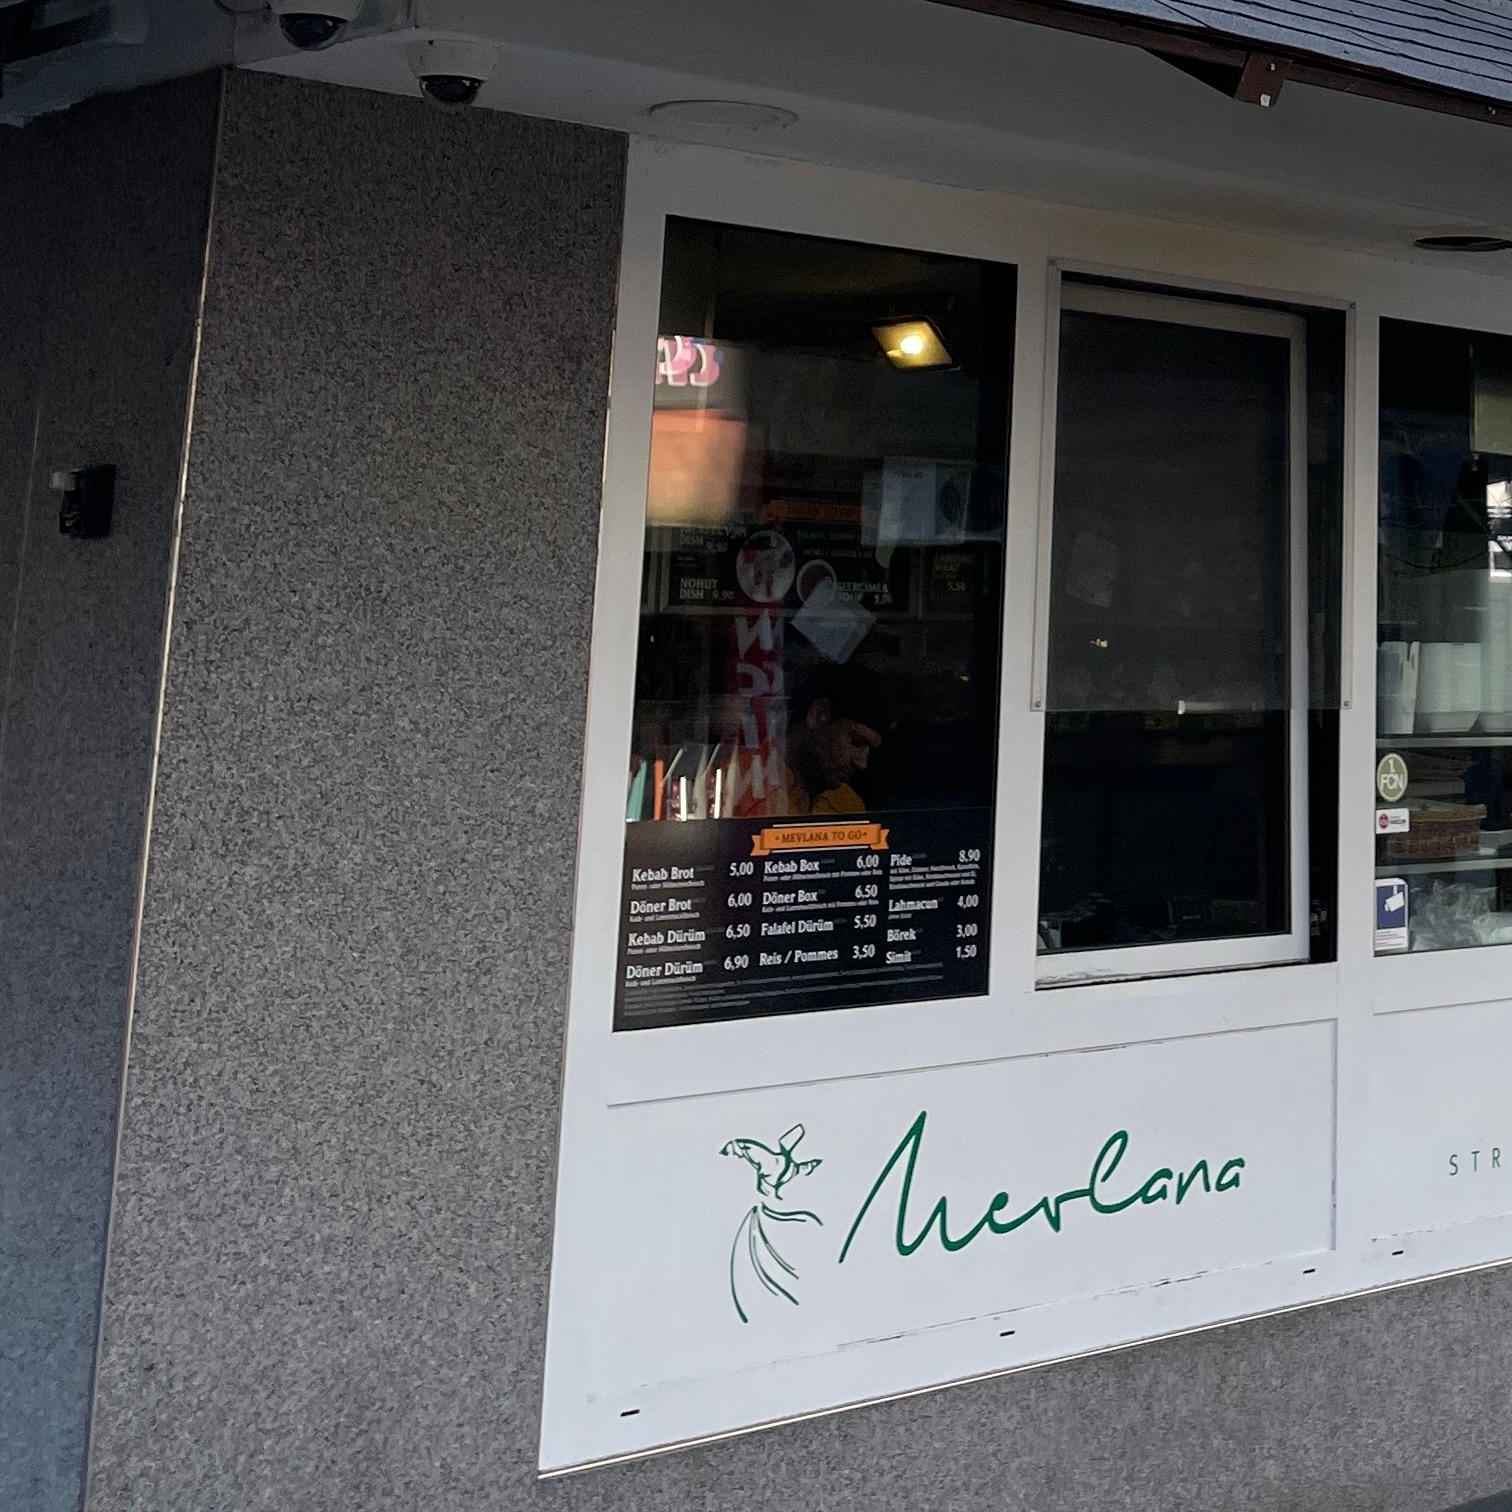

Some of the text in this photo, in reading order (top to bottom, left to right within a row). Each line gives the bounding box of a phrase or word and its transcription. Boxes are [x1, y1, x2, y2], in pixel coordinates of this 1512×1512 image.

[782, 830, 863, 843] MEVLANA TO GO
[764, 854, 880, 874] Kebab Box 6,00
[890, 849, 981, 866] Pide 8,90
[632, 868, 669, 882] Kebab
[670, 867, 694, 880] Brot
[729, 862, 754, 876] 5,00
[630, 900, 666, 914] Döner
[668, 898, 692, 912] Brot
[727, 893, 752, 908] 6,00
[763, 884, 878, 905] Döner Box 6,50
[957, 894, 979, 909] 4,00
[628, 923, 751, 946] Kebab Dürüm 6,50
[761, 922, 796, 936] Falafel
[797, 919, 834, 933] Dürüm
[854, 914, 877, 929] 5,50
[887, 923, 978, 942] Börek 3,00
[759, 952, 782, 966] Reis
[793, 949, 839, 963] Pommes
[852, 944, 876, 959] 3,50
[886, 944, 977, 964] Simit 1,50
[626, 964, 661, 979] Döner
[664, 960, 703, 975] Dürüm
[724, 954, 750, 970] 6,90
[838, 1110, 1246, 1264] Mevlana
